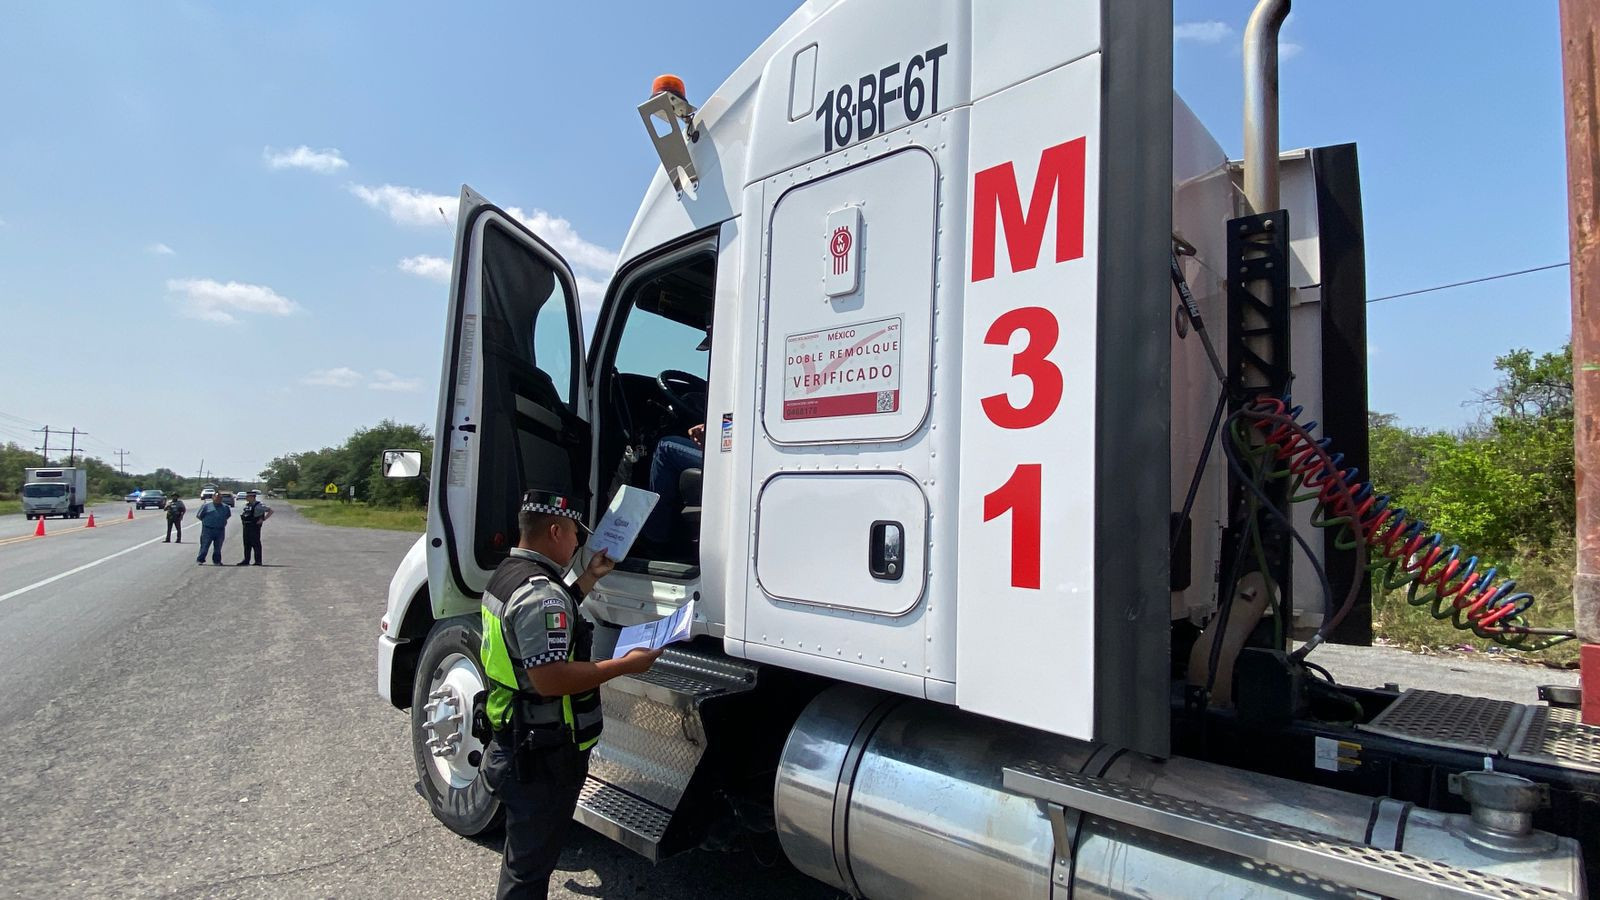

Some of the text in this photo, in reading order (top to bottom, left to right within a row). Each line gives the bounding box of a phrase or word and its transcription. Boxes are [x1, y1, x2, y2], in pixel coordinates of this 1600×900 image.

[827, 329, 856, 341] MÉXICO
[887, 324, 899, 332] SCT
[788, 341, 899, 366] DOBLE REMOLQUE
[793, 364, 893, 388] VERIFICADO
